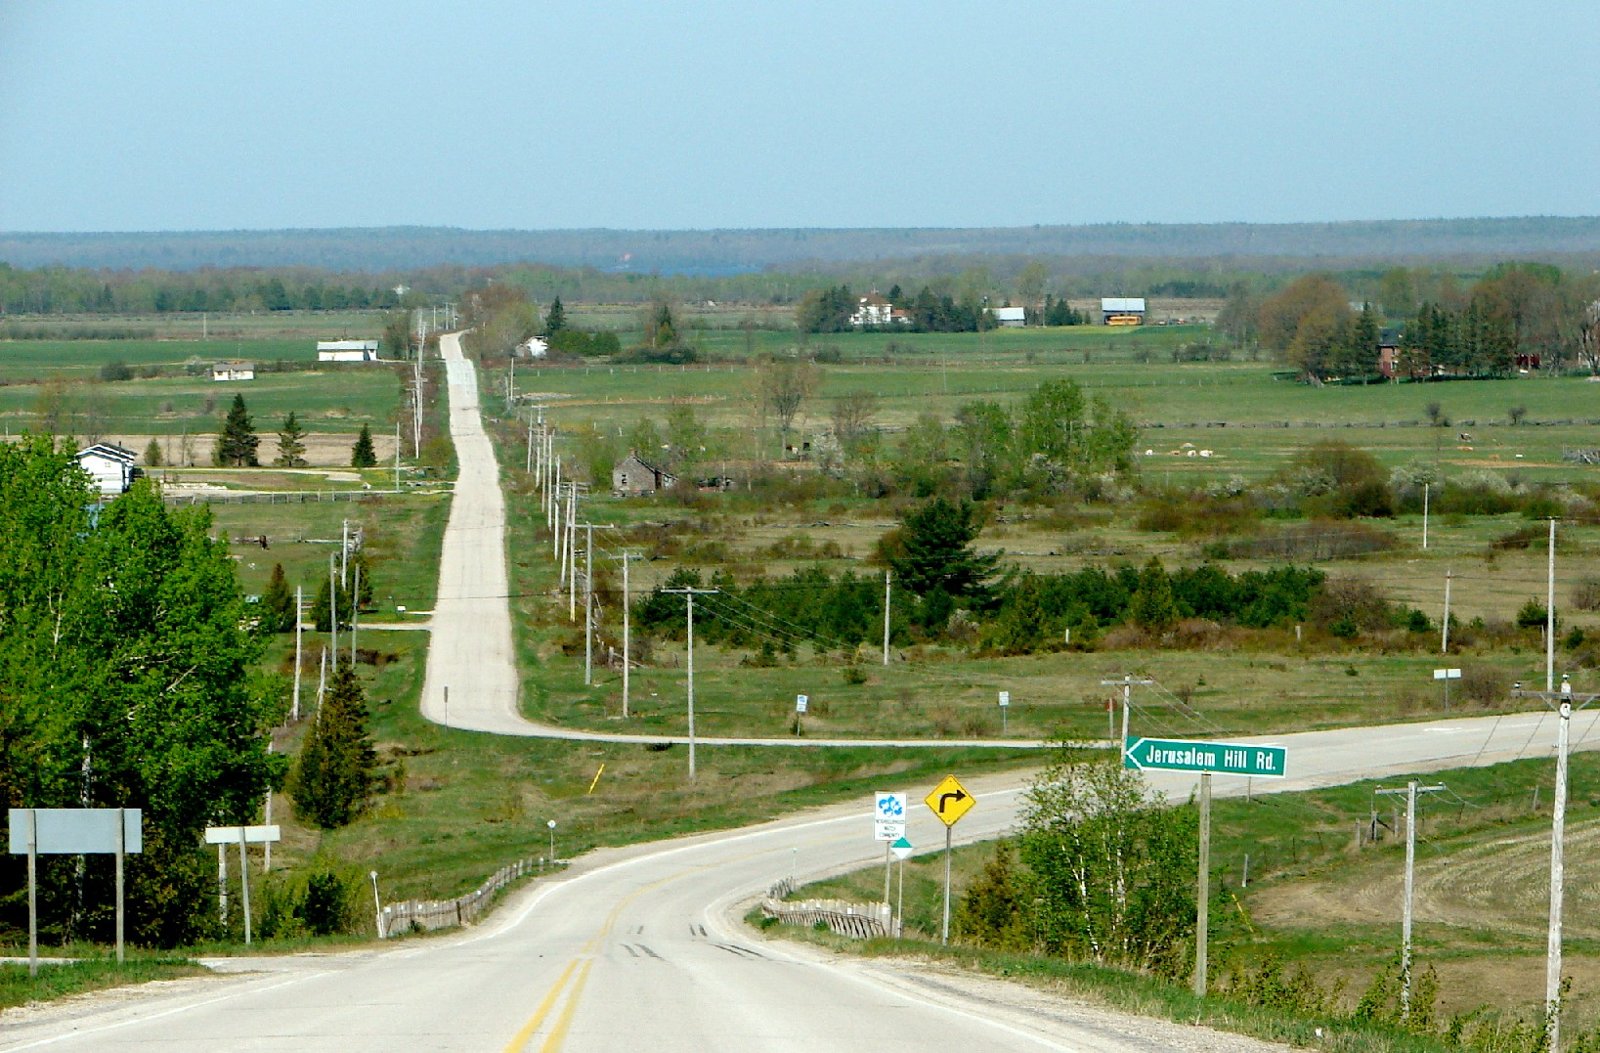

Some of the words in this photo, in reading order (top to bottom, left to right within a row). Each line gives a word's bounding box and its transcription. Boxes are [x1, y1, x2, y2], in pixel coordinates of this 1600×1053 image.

[1146, 745, 1215, 767] Jerusalem
[1224, 749, 1247, 769] Hill
[1256, 751, 1276, 771] Rd.
